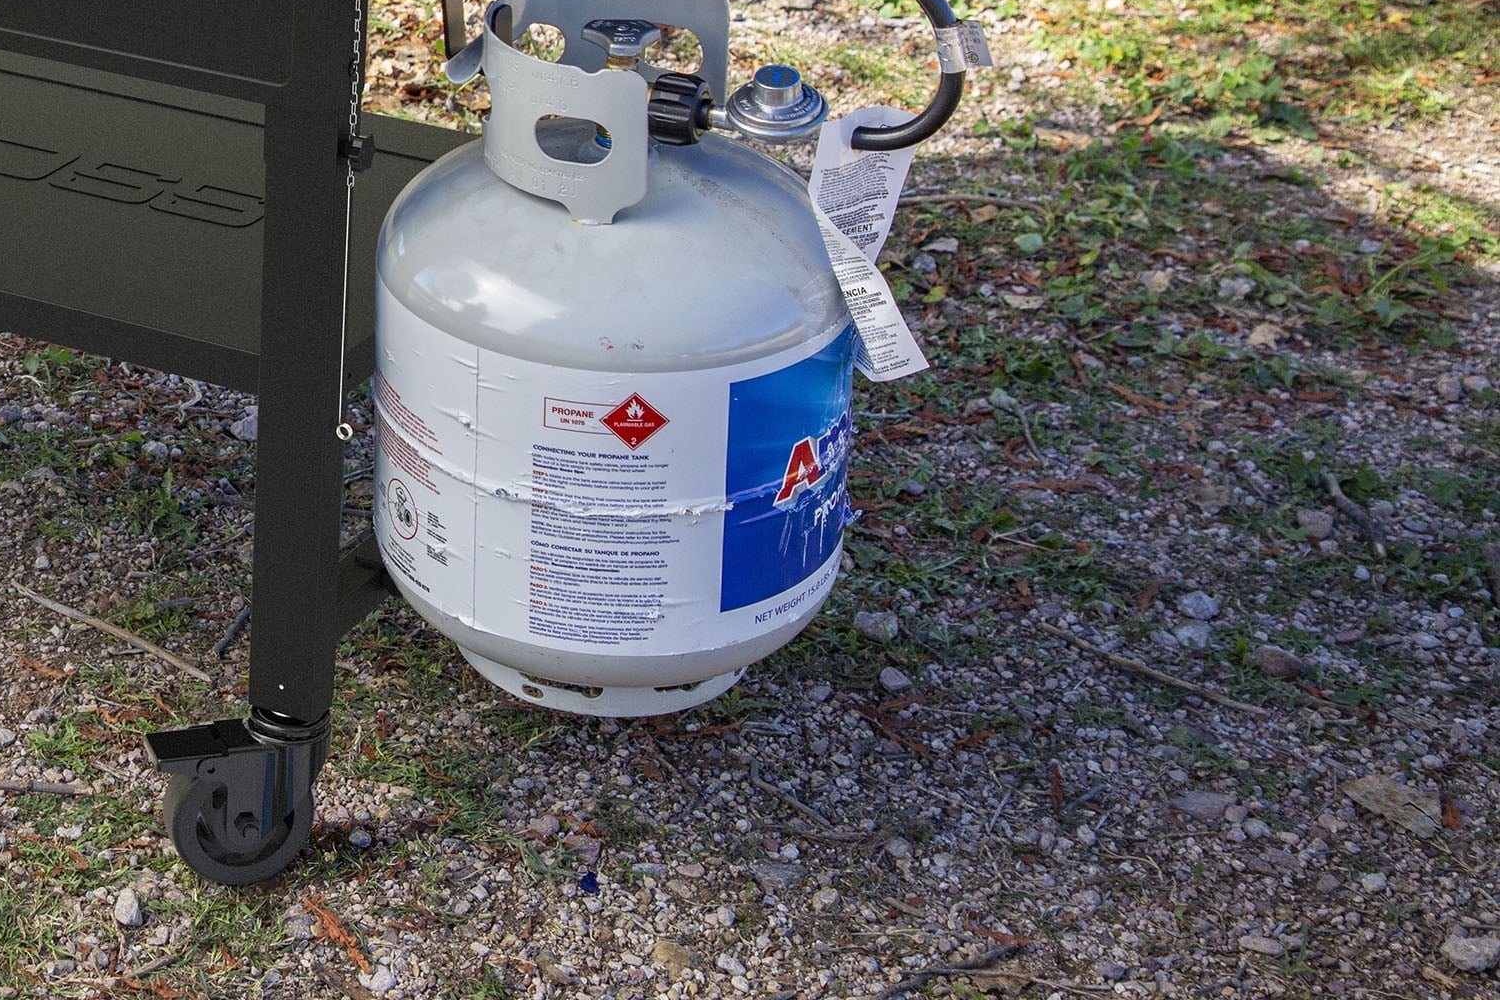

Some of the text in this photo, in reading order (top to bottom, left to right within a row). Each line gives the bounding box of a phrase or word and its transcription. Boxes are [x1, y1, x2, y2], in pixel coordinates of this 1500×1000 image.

[551, 406, 594, 419] PROPANE
[631, 437, 637, 445] 2
[533, 444, 576, 457] CONNECTING
[578, 451, 597, 459] YOUR
[551, 543, 583, 554] CONECTAR
[594, 549, 618, 557] TANQUE
[754, 609, 774, 624] NET
[774, 591, 806, 616] WEIGHT
[807, 581, 820, 597] 15.0
